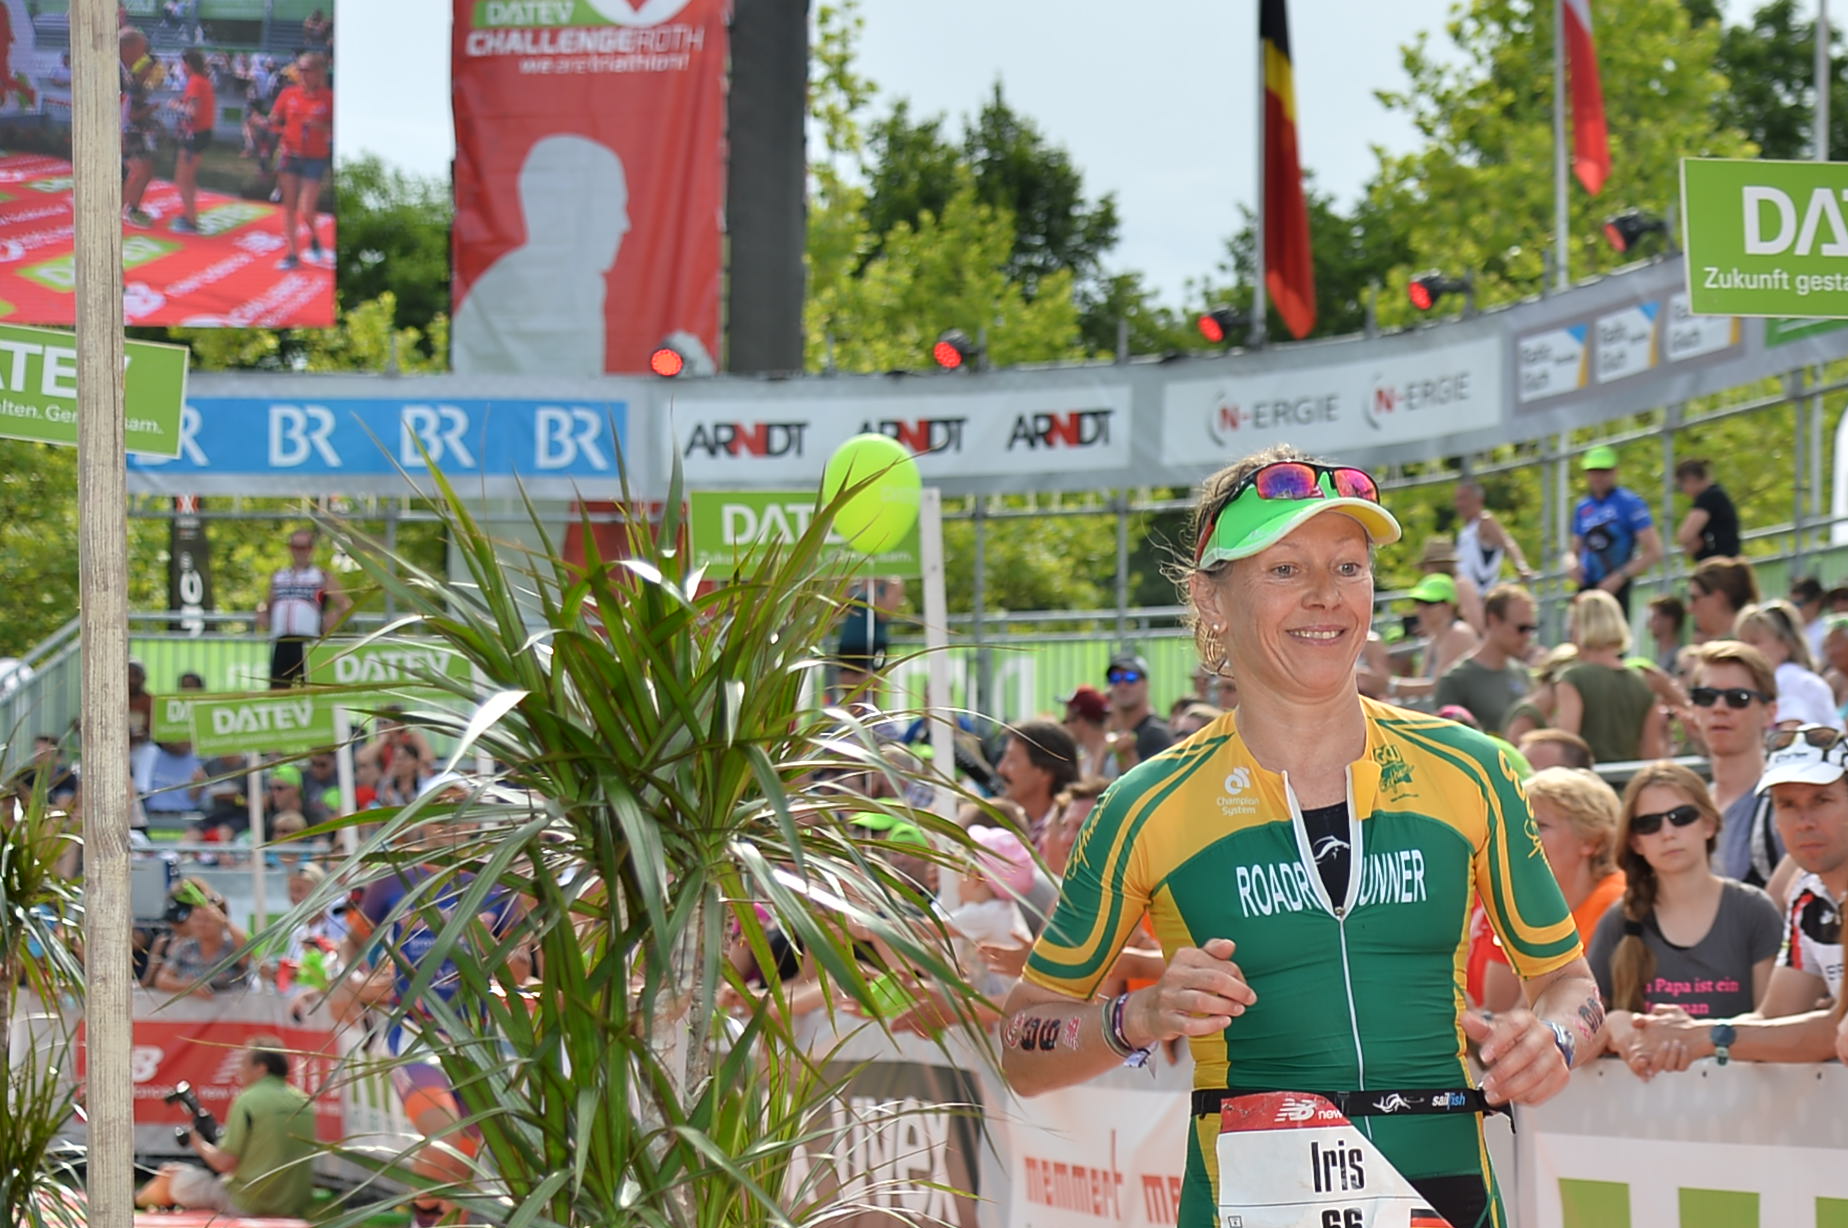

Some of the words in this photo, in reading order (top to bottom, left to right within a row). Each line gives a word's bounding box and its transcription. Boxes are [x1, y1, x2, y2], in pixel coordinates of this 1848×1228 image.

[486, 1, 575, 26] DATEV
[1703, 267, 1790, 291] Zukunft
[1375, 371, 1471, 412] N-ERGIE
[1007, 408, 1115, 449] ARNDT
[1219, 393, 1340, 430] N-ERGIE
[268, 405, 343, 468] BR
[401, 405, 477, 469] BR
[534, 406, 610, 471] BR
[685, 421, 810, 459] ARNDT
[334, 651, 450, 683] DATEV
[212, 701, 314, 735] DATEV
[1216, 796, 1260, 808] Champion
[1221, 805, 1256, 817] System
[1655, 977, 1692, 997] Papa
[1694, 977, 1714, 993] ist
[1716, 977, 1740, 993] ein
[1318, 1109, 1342, 1120] new
[1431, 1093, 1466, 1111] sailfish
[1024, 1129, 1123, 1221] memmert
[1310, 1140, 1365, 1193] Iris
